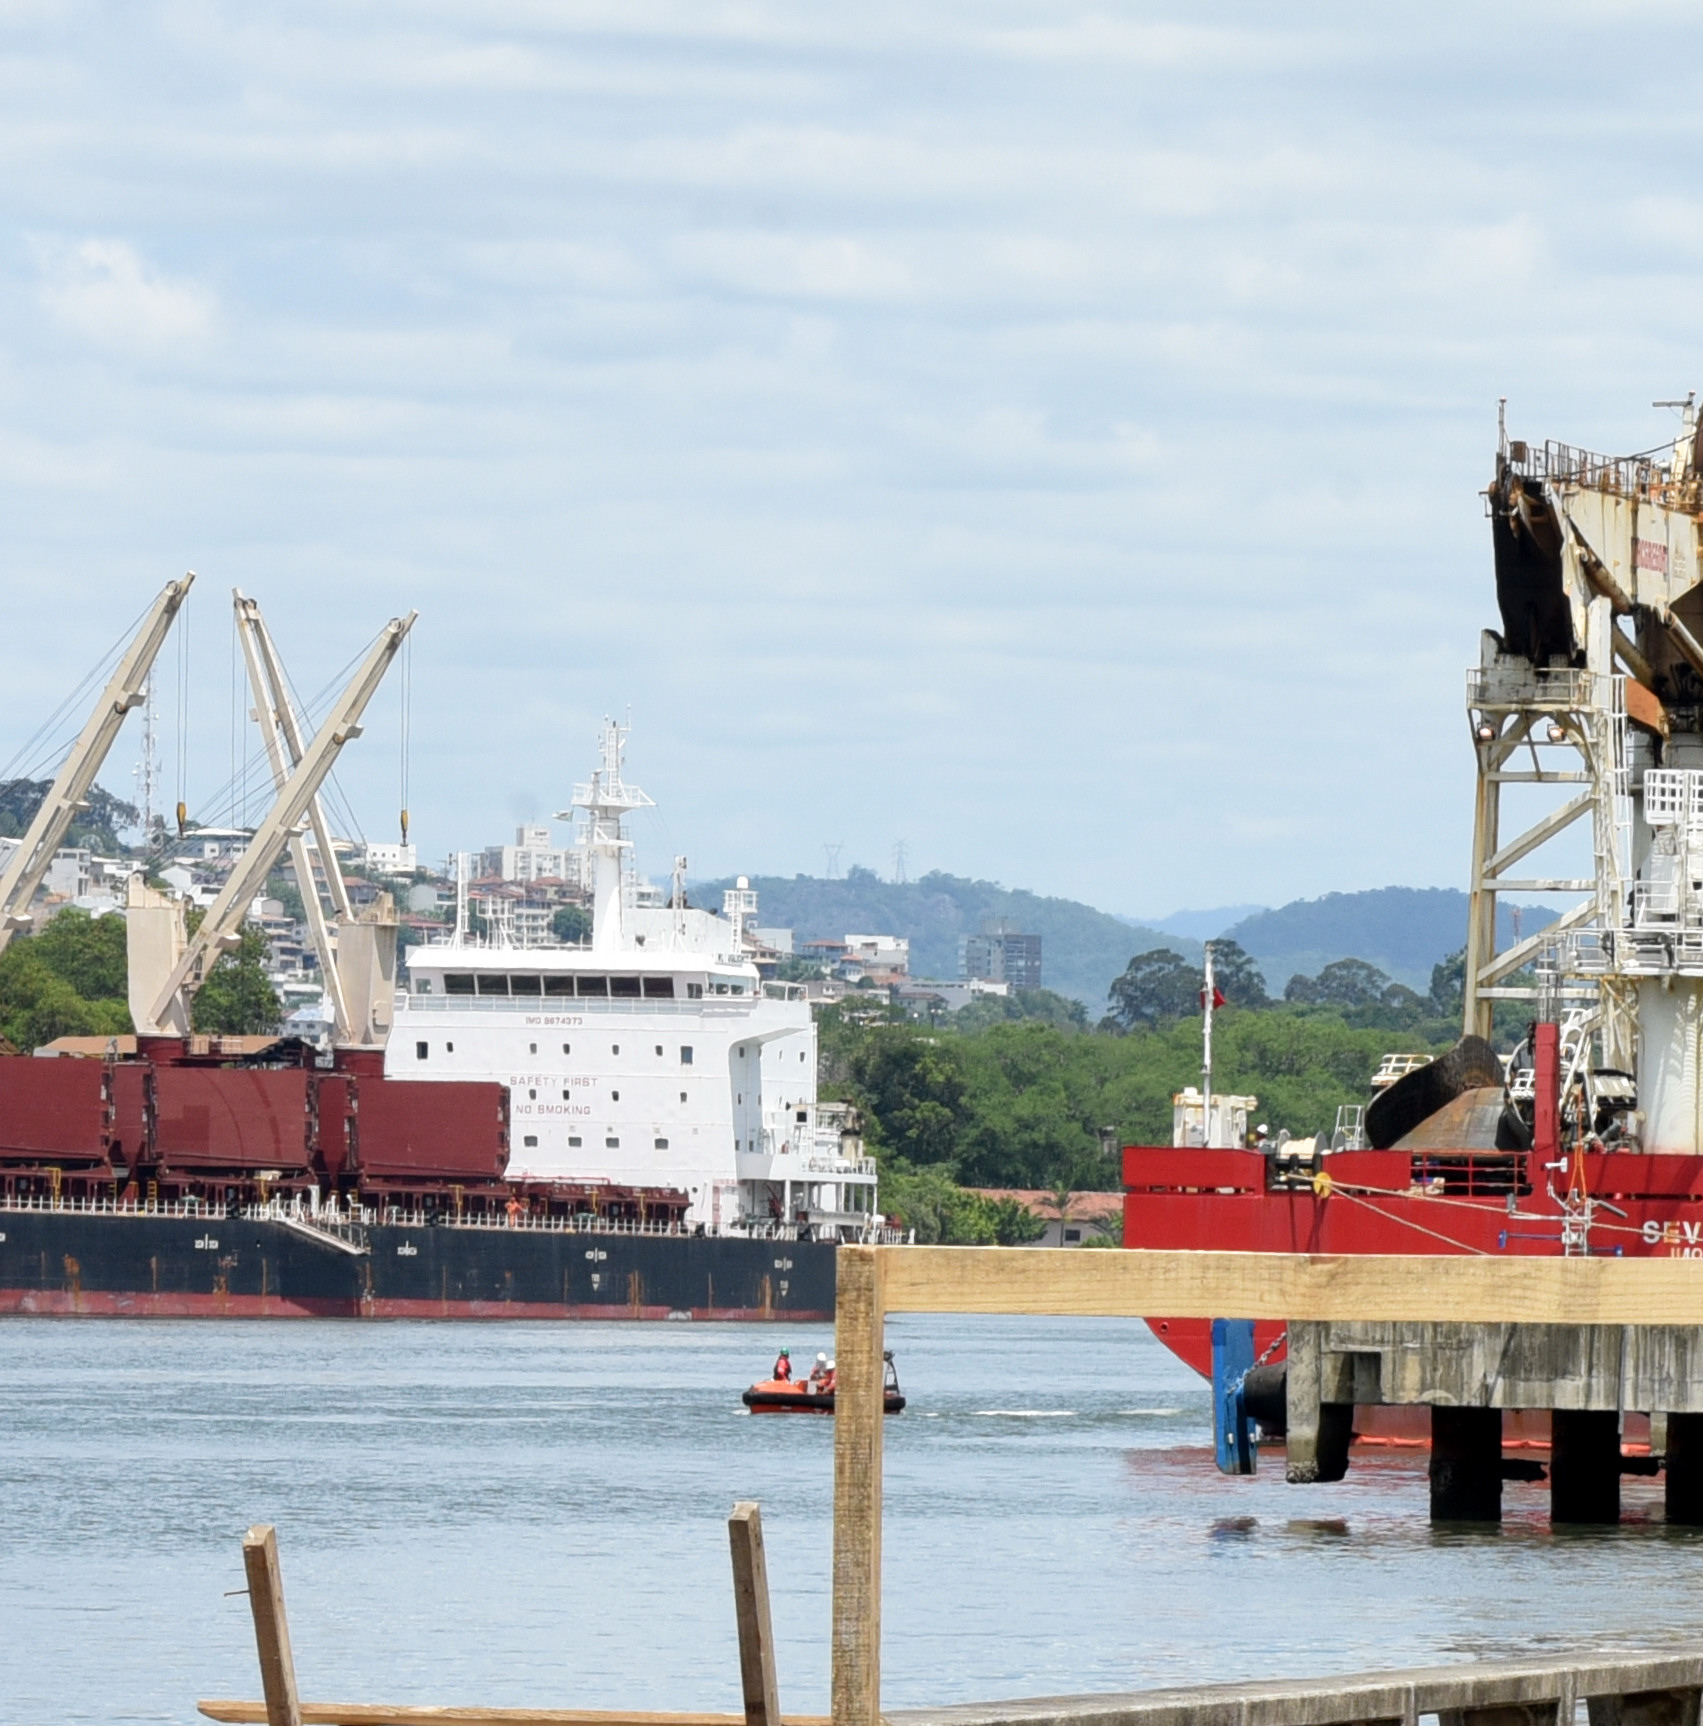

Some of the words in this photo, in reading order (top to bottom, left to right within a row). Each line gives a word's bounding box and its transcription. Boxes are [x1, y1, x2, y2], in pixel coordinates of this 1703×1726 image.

[510, 1076, 557, 1087] SAFETY
[563, 1077, 598, 1087] FIRST
[515, 1104, 532, 1115] NO
[538, 1105, 591, 1116] SMOKING
